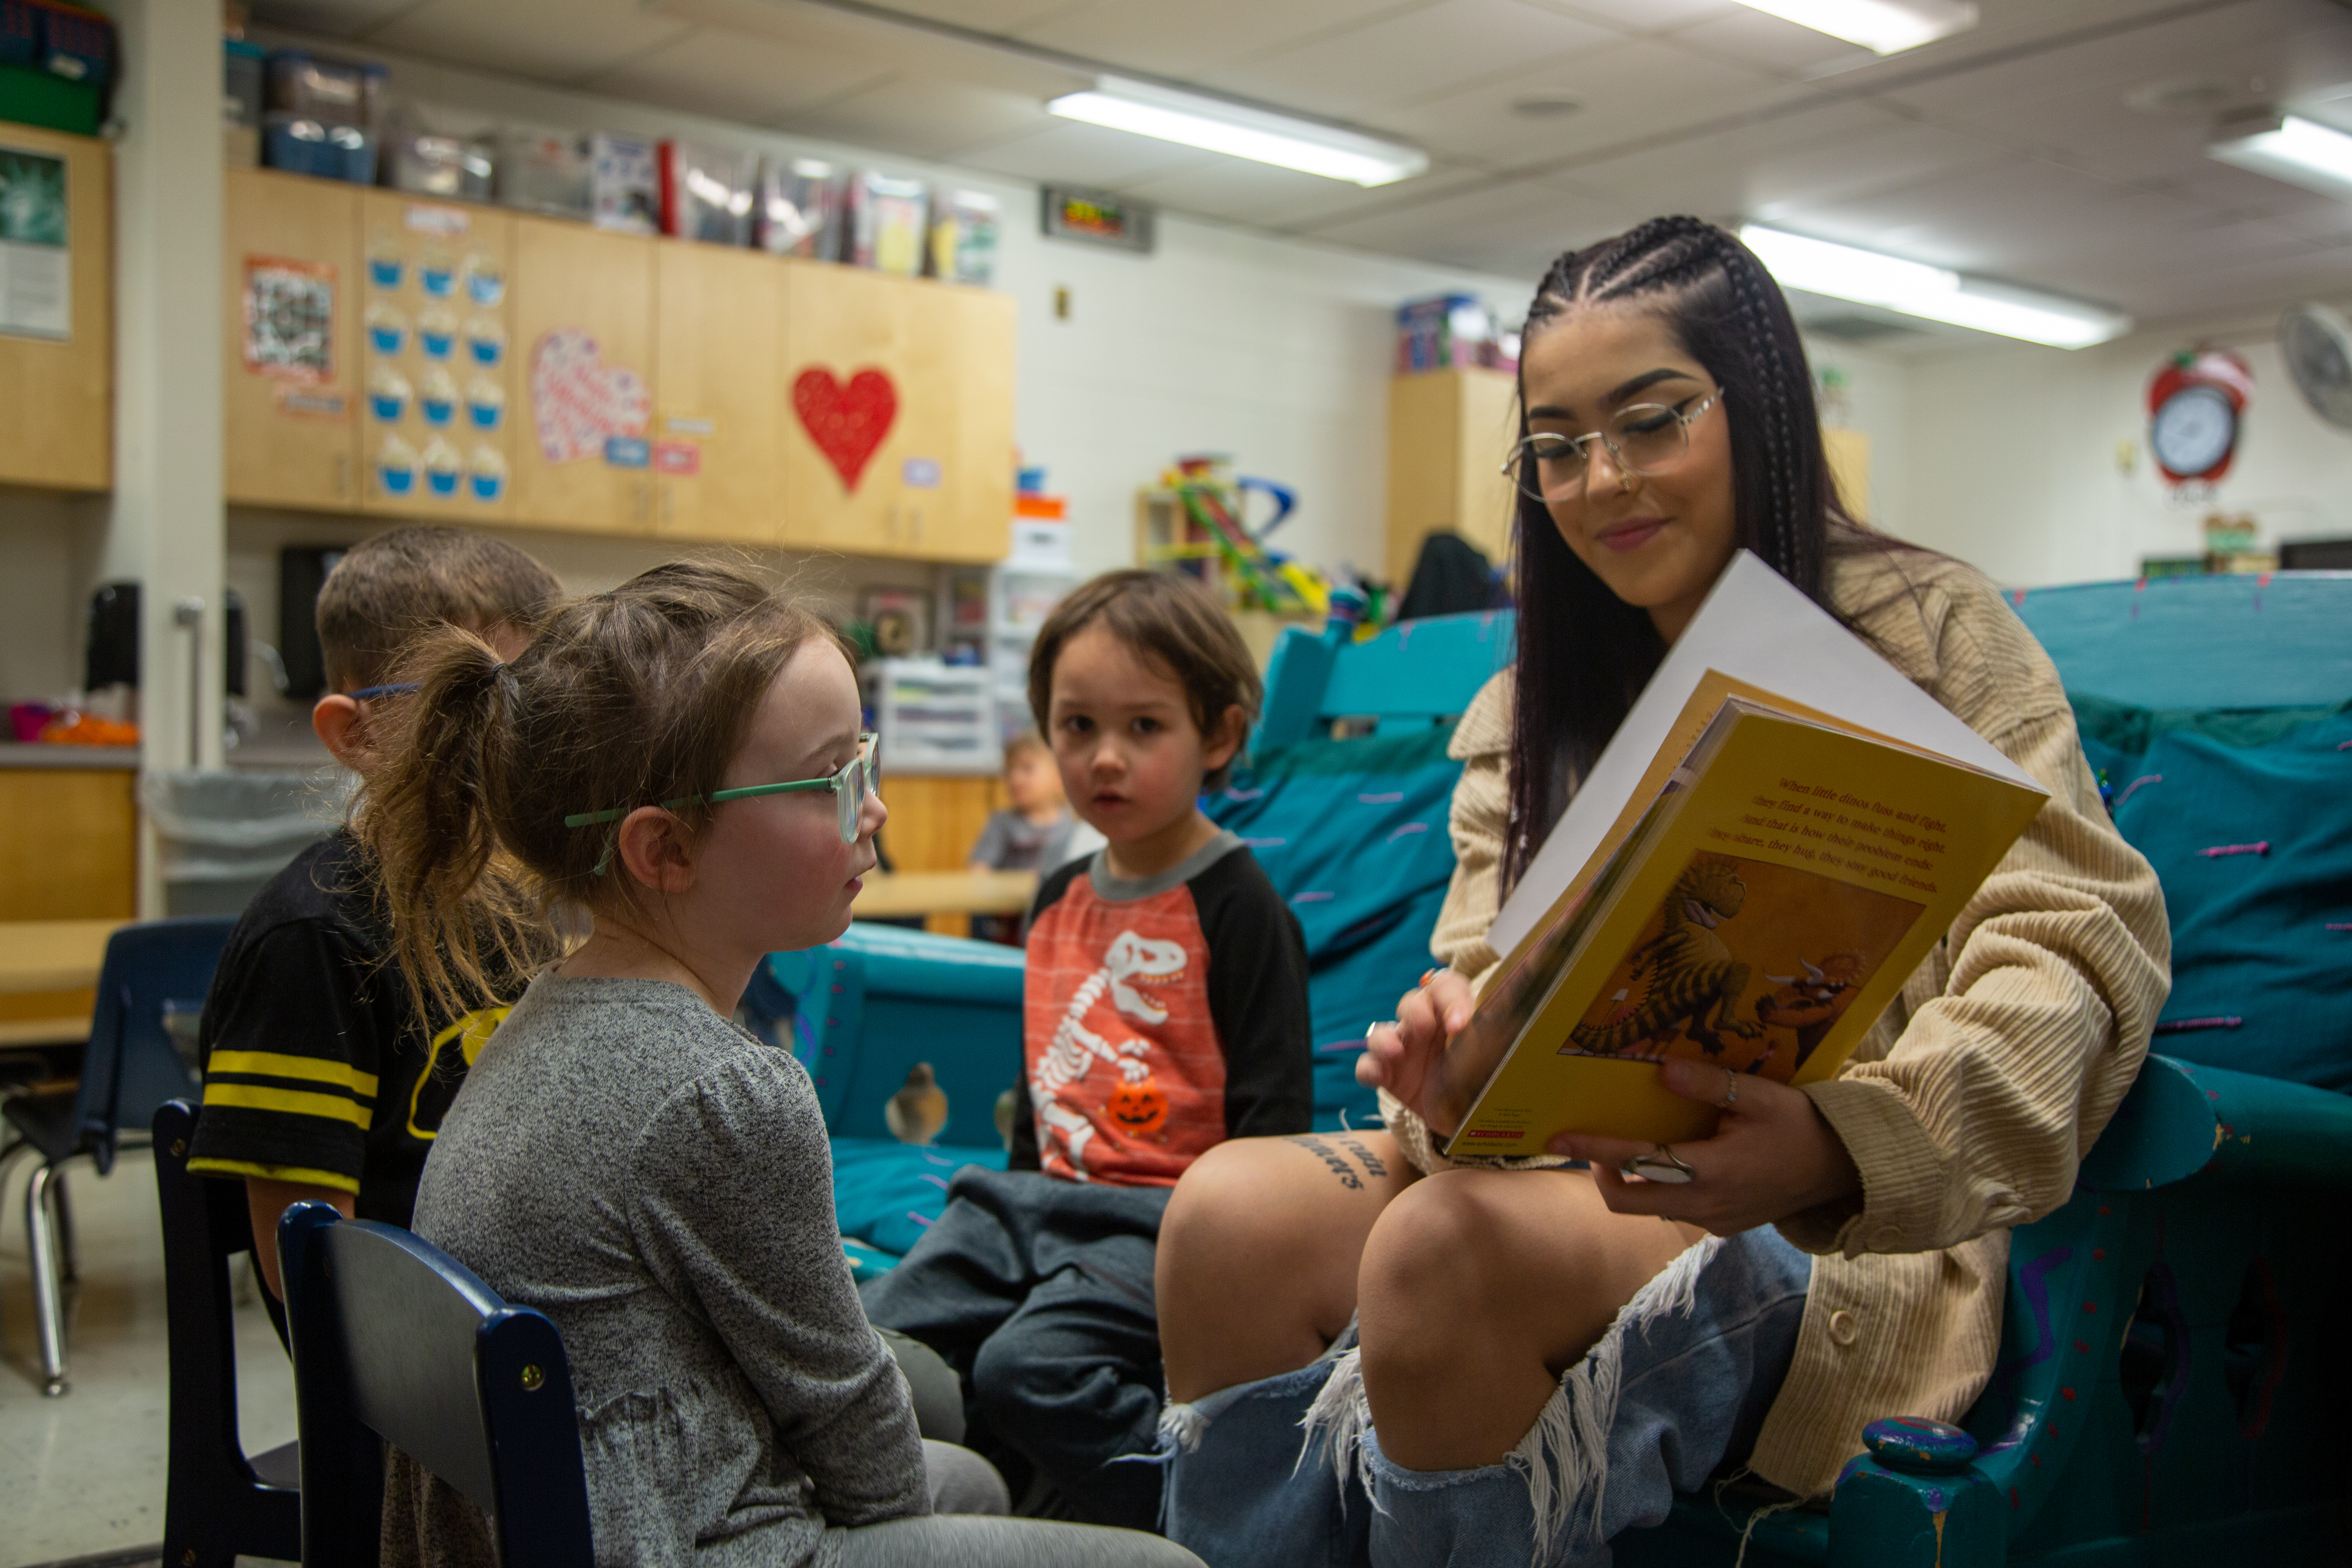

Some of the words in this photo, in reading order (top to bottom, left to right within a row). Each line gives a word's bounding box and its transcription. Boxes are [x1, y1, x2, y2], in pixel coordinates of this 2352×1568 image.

[1779, 778, 1811, 794] When
[1812, 786, 1837, 800] little
[1839, 793, 1869, 809] dinos
[1871, 801, 1893, 816] fuss
[1895, 811, 1919, 823] and
[1767, 819, 1788, 831] that
[1789, 823, 1798, 832] is
[1801, 826, 1825, 839] how
[1827, 833, 1855, 846] their
[1778, 800, 1803, 813] find
[1813, 809, 1835, 822] way
[1837, 815, 1849, 824] to
[1851, 819, 1882, 834] make
[1882, 829, 1915, 845] things
[1768, 840, 1792, 853] they
[1793, 844, 1815, 859] hug,
[1819, 851, 1842, 866] they
[1867, 867, 1900, 881] good
